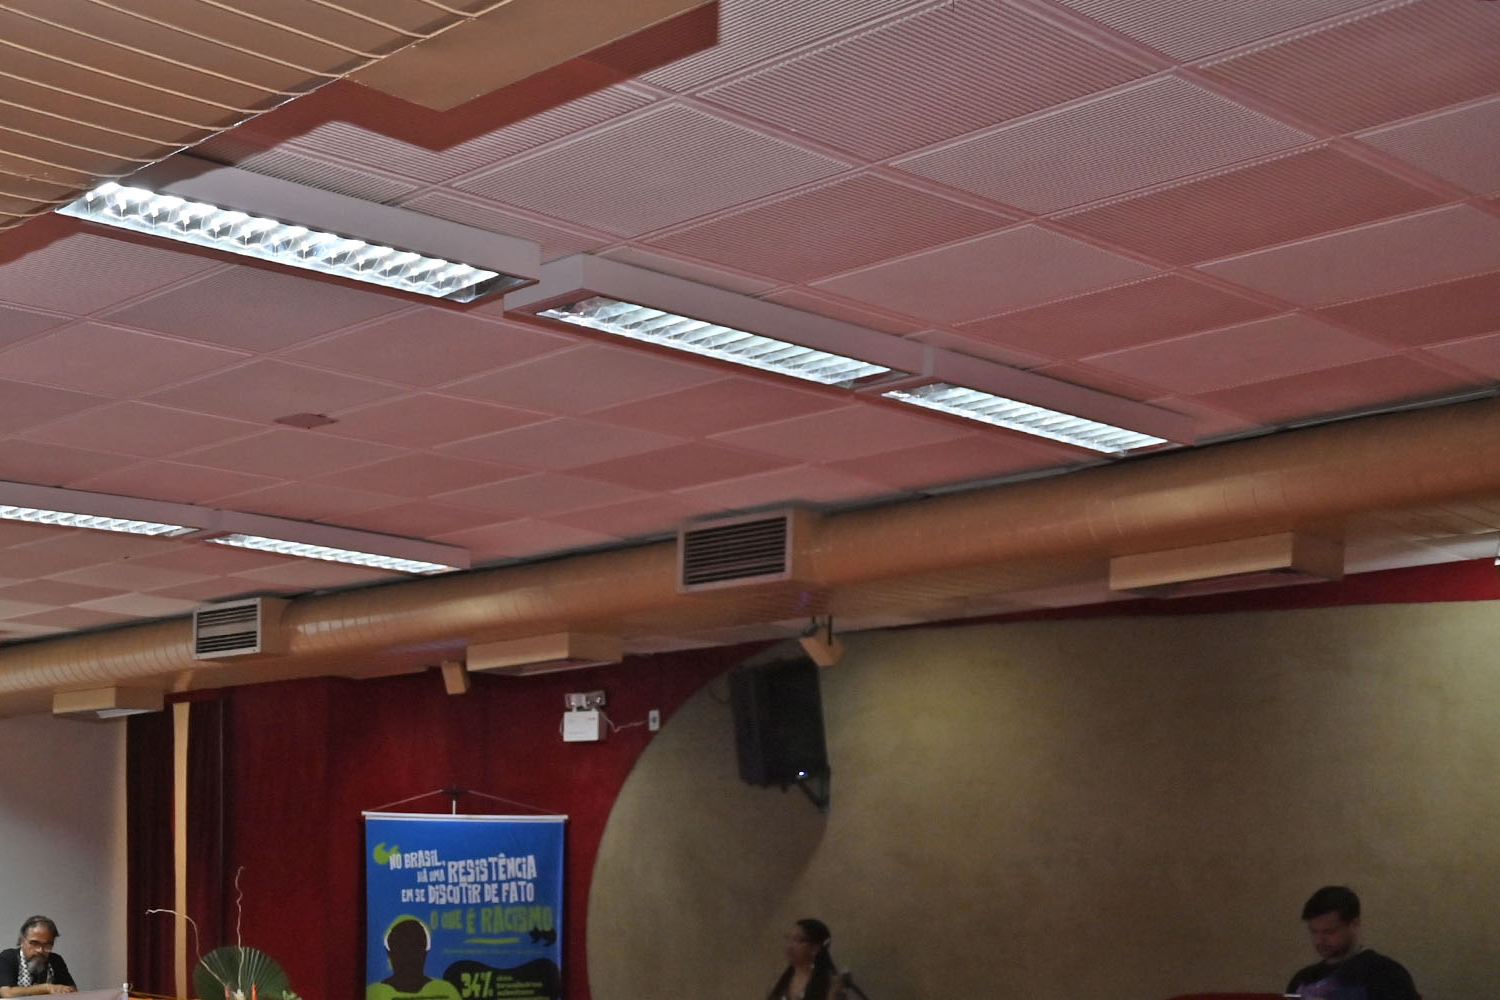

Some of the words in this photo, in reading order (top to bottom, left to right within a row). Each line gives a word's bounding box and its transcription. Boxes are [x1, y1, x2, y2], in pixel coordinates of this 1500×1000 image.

[389, 853, 402, 870] NO
[401, 888, 414, 902] EM
[415, 888, 426, 902] SE
[484, 884, 500, 903] DE
[501, 881, 535, 903] FATO
[481, 904, 553, 934] RACISMO
[460, 970, 493, 999] 34%
